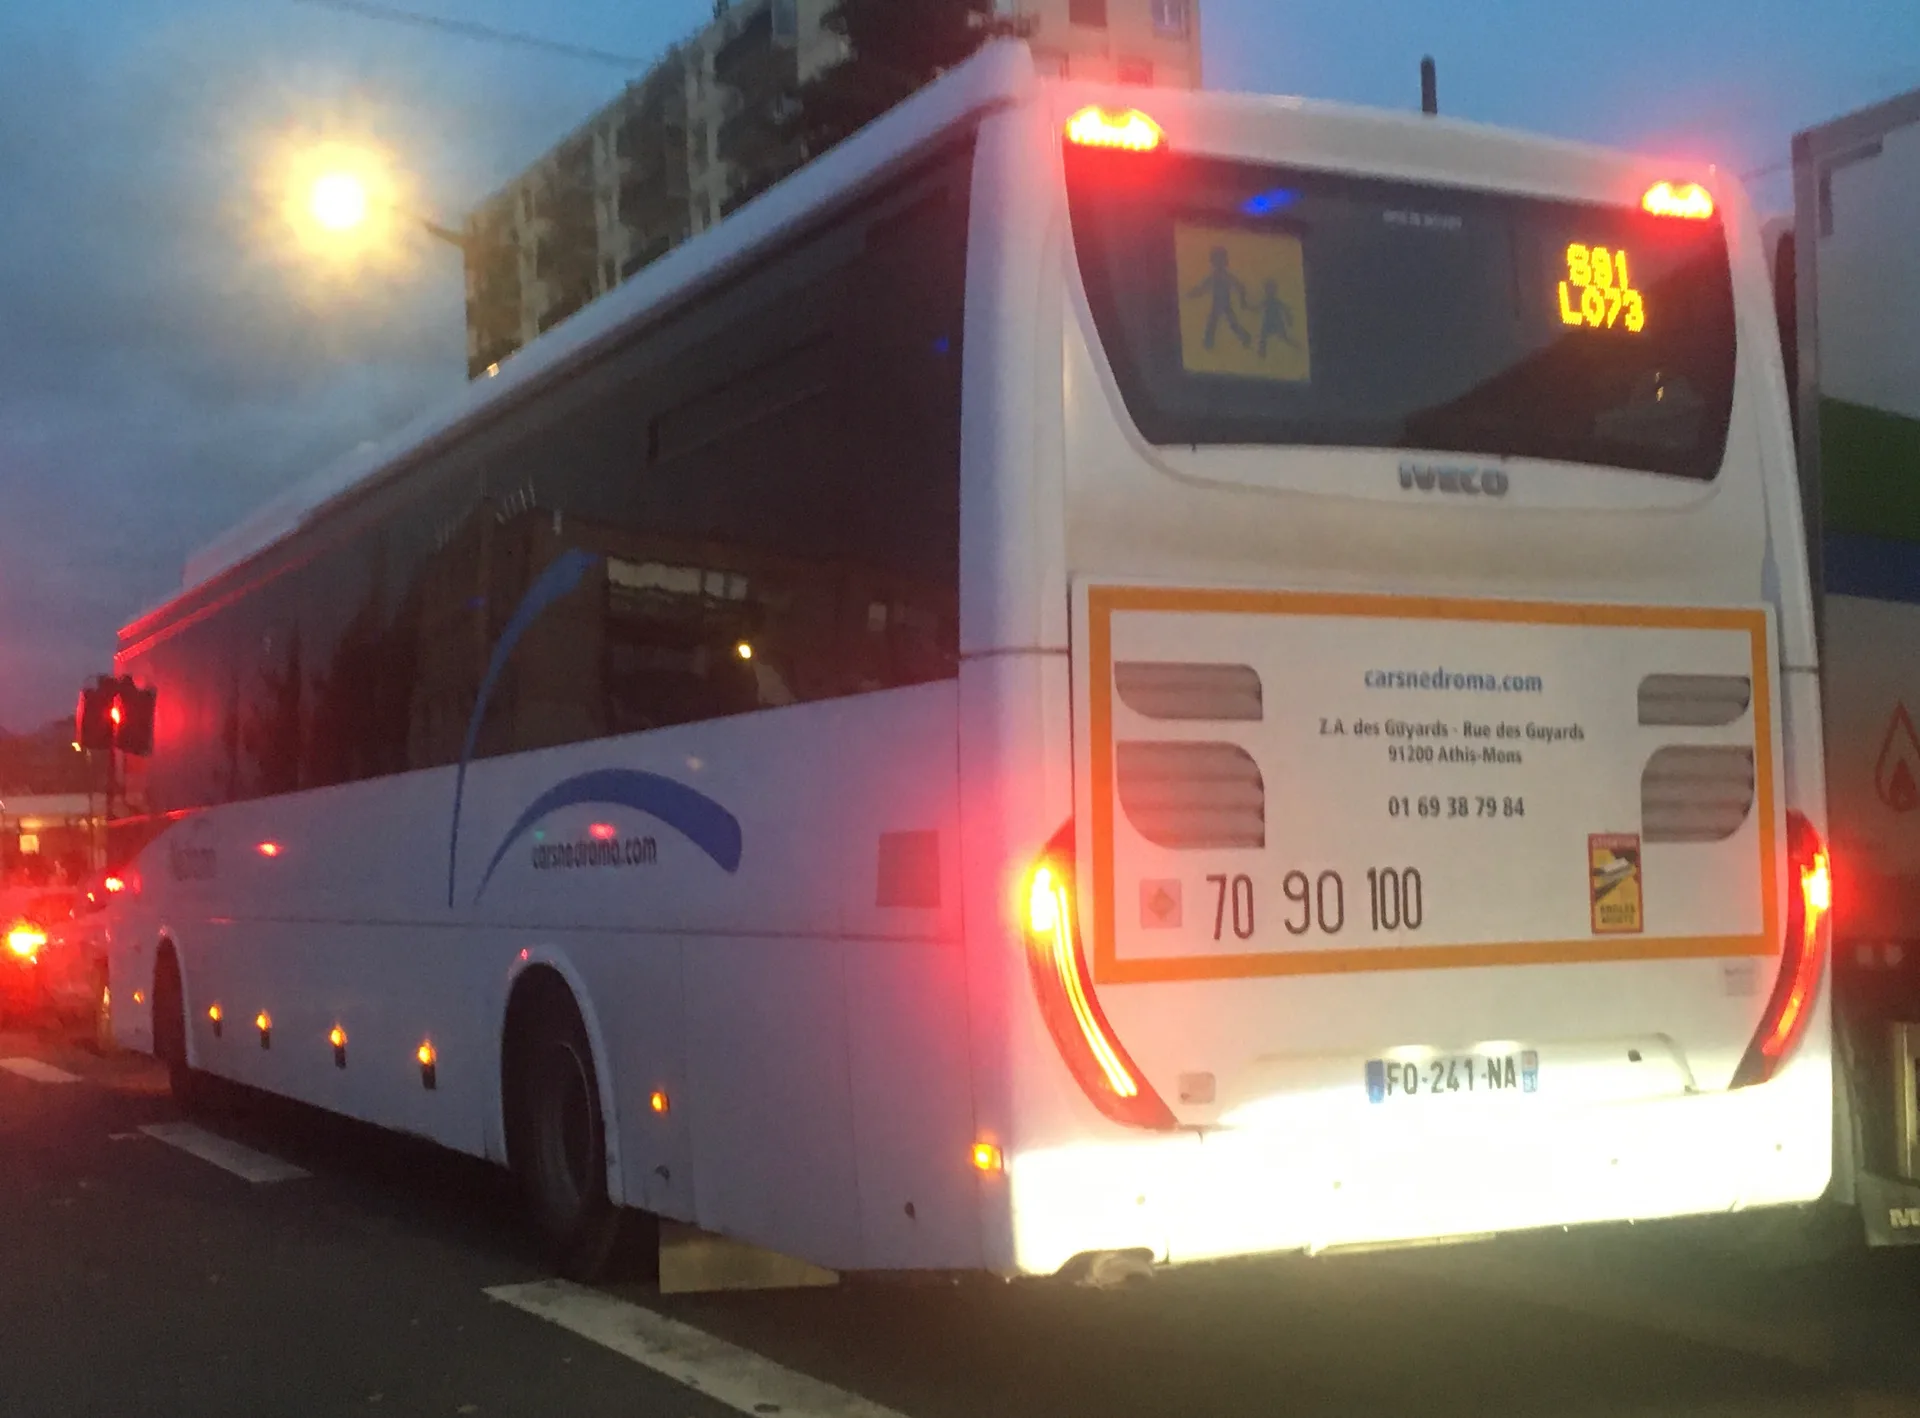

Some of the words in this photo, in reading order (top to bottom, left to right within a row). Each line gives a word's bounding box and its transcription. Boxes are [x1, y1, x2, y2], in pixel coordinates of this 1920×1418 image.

[1400, 463, 1509, 496] IVECO
[1364, 667, 1543, 692] carsnedroma.com
[1353, 717, 1380, 737] des
[1384, 718, 1449, 741] Guyards
[1463, 720, 1492, 739] Rue
[1496, 721, 1522, 740] des
[1526, 722, 1586, 743] Guyards
[1388, 744, 1434, 764] 91200
[1437, 745, 1524, 766] Athis-Mons
[1388, 796, 1410, 818] 01
[1417, 796, 1441, 818] 69
[1447, 797, 1470, 818] 38
[1475, 797, 1498, 818] 79
[1503, 797, 1526, 818] 84
[1206, 873, 1254, 940] 70
[1283, 869, 1345, 934] 90
[1367, 866, 1423, 930] 100
